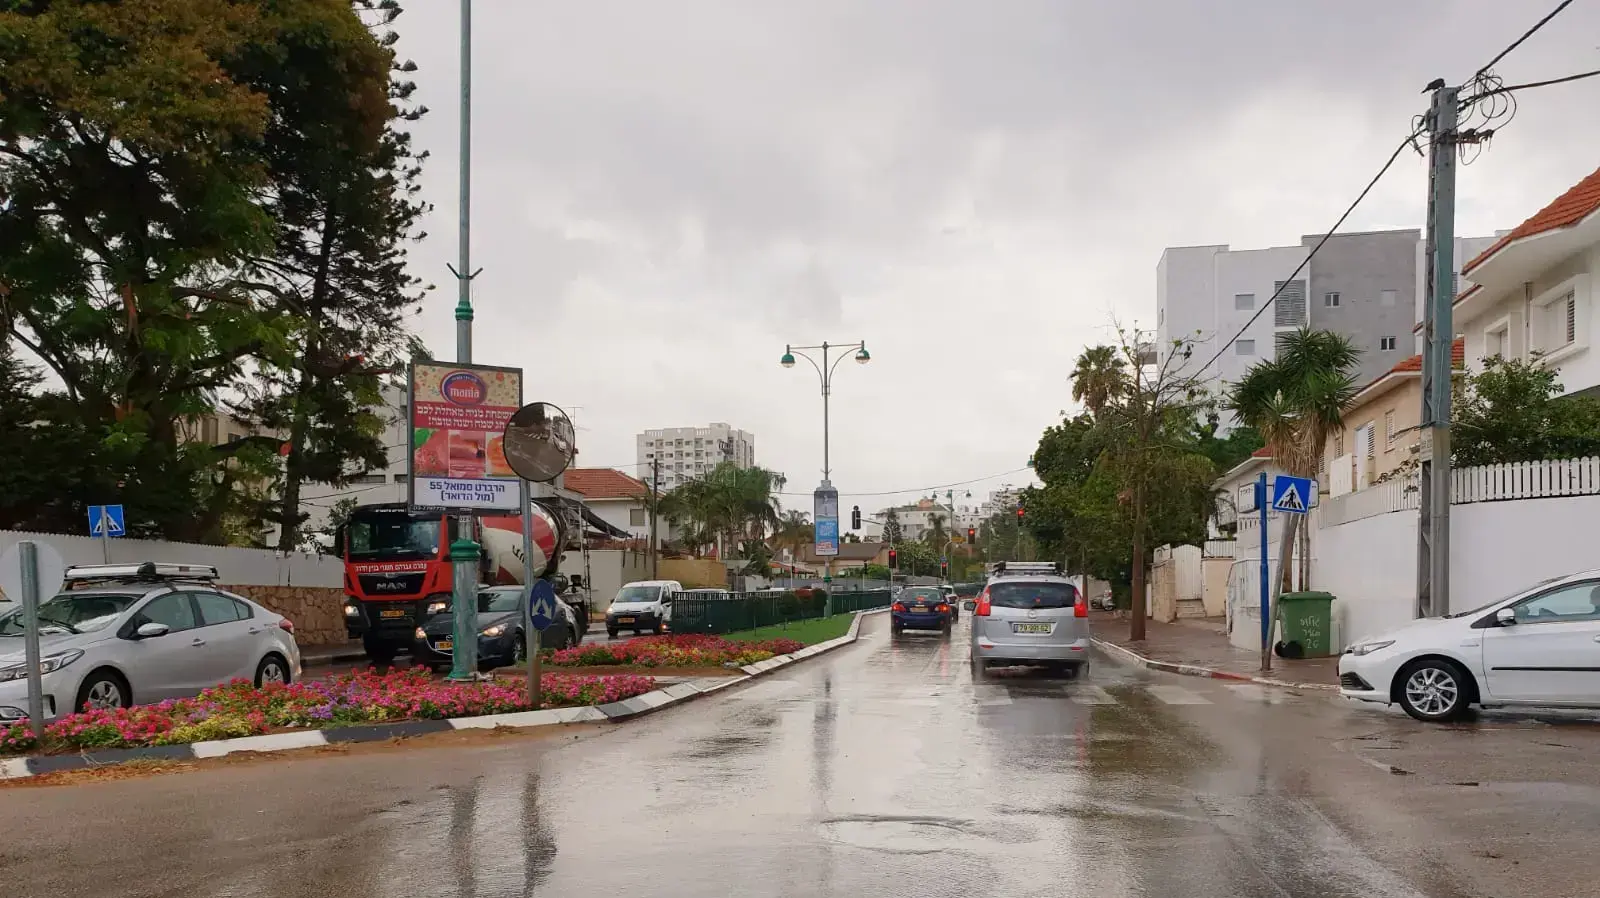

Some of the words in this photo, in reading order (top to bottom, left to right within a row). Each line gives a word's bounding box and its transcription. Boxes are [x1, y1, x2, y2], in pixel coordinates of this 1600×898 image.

[417, 404, 433, 414] לכם
[435, 405, 464, 417] מאחלת
[453, 419, 473, 428] ושנה
[475, 420, 493, 429] שמח
[429, 481, 442, 490] 55
[444, 480, 473, 491] סמואל
[475, 483, 505, 493] הרברט
[376, 582, 407, 590] MAN
